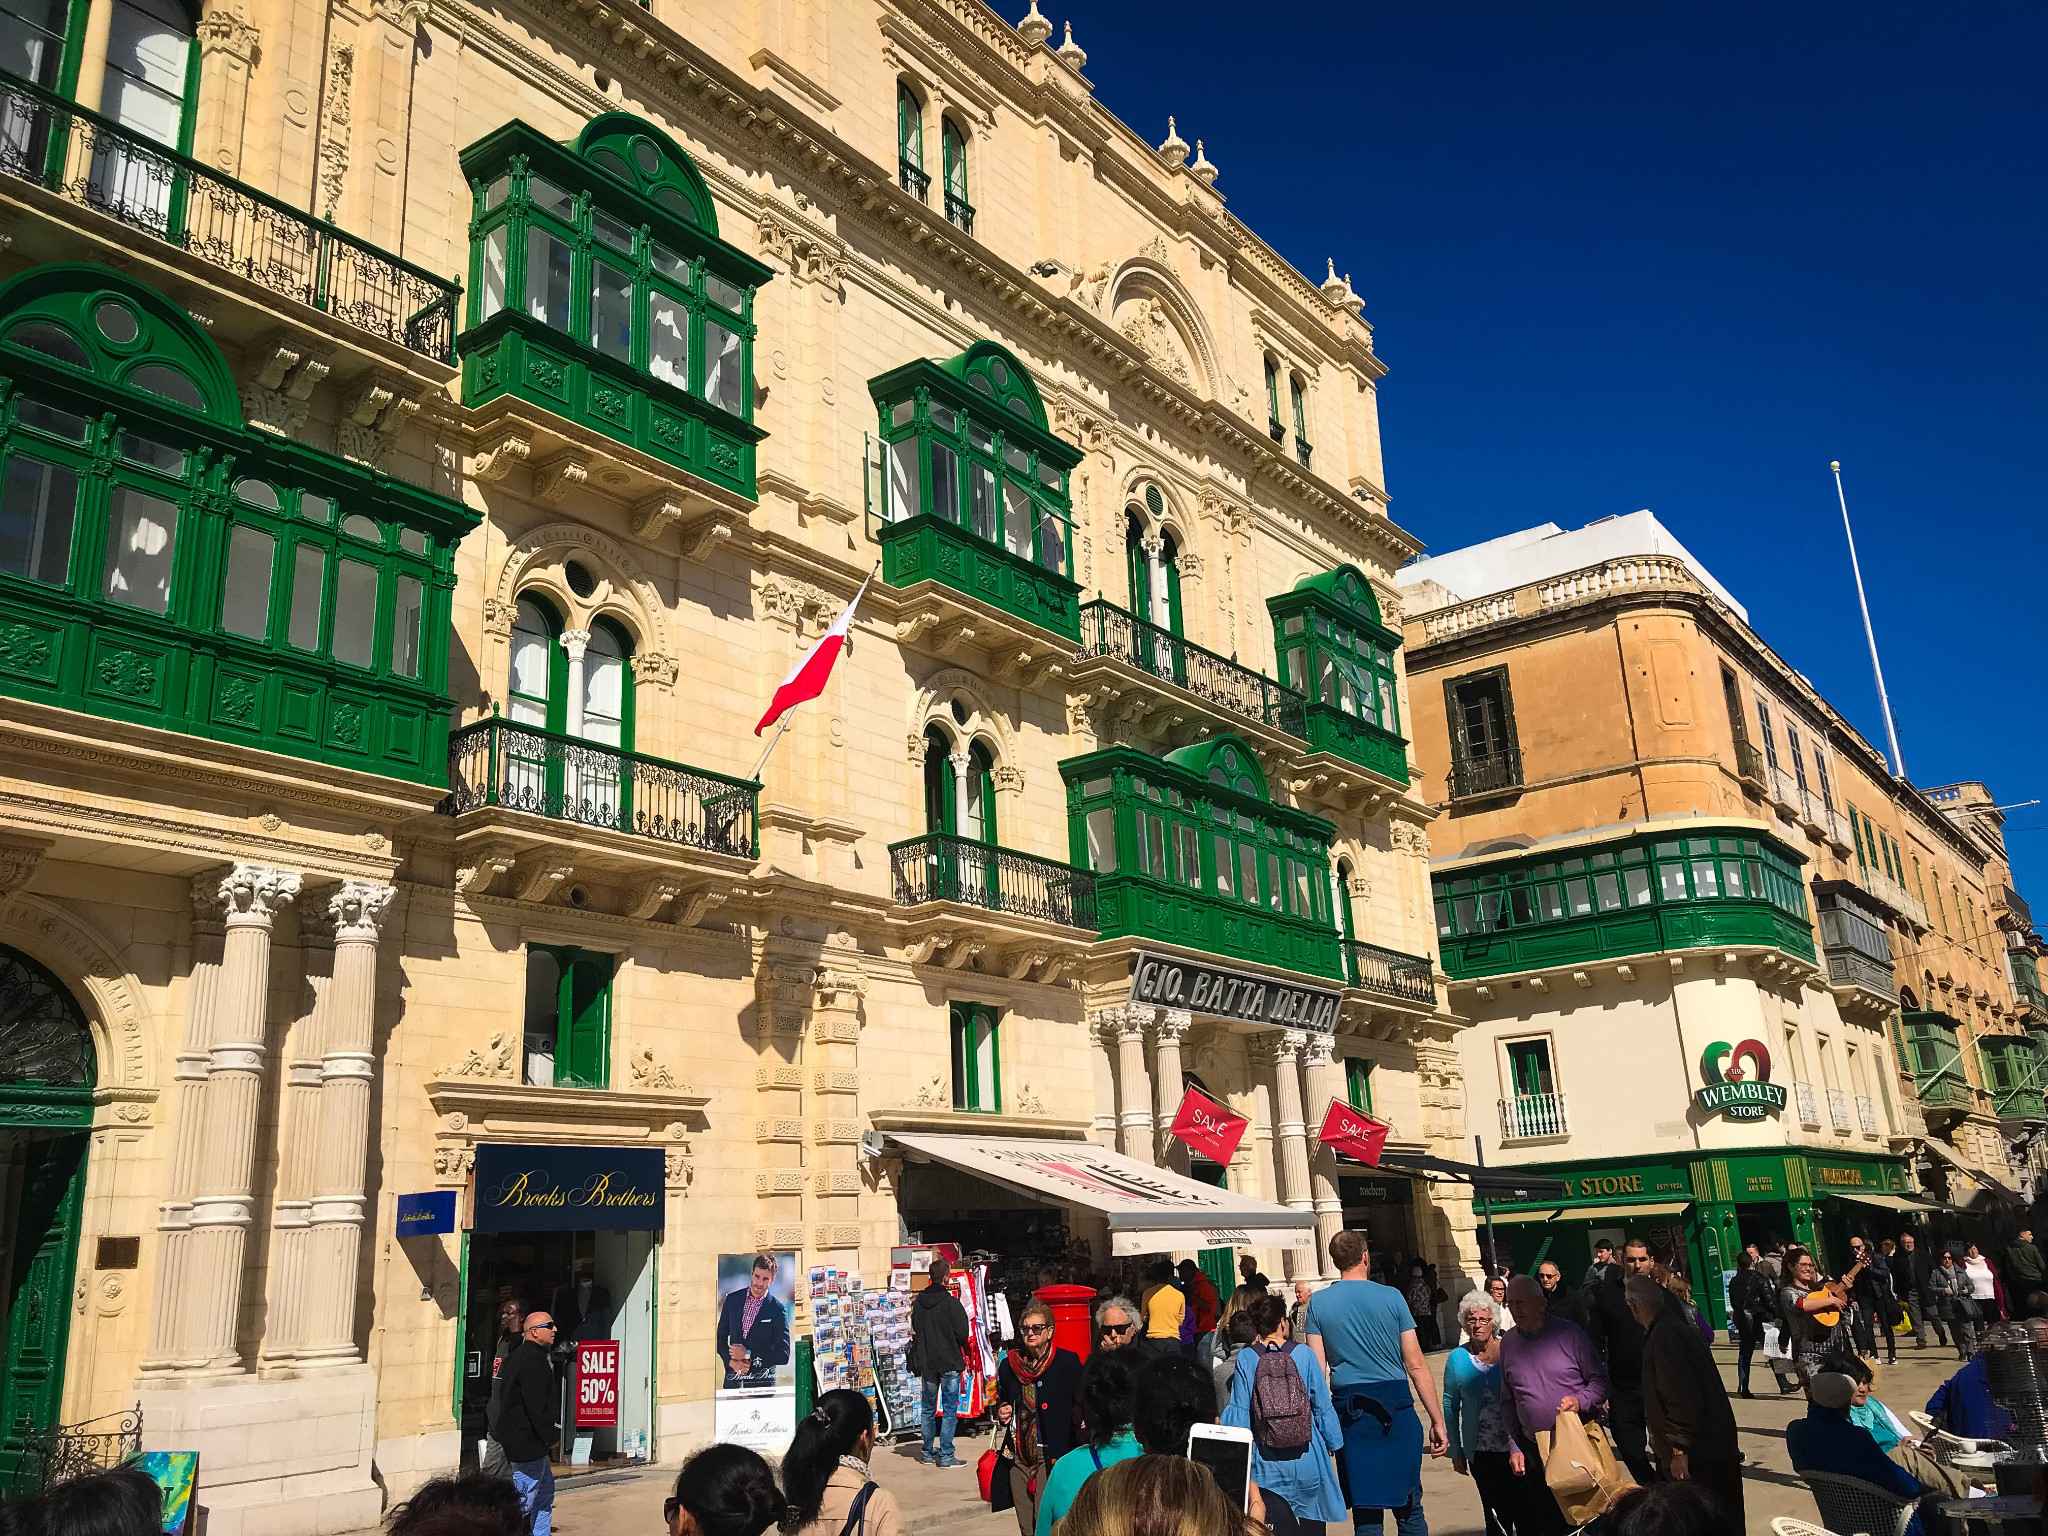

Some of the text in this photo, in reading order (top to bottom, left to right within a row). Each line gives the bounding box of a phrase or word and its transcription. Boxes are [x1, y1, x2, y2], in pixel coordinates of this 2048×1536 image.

[1141, 962, 1334, 1028] GIO. BATTA DELIA
[1702, 1083, 1783, 1108] WEMBLEY
[1193, 1108, 1228, 1138] SALE
[1730, 1105, 1765, 1117] STORE
[1340, 1118, 1371, 1142] SALE
[486, 1168, 657, 1208] Brooks Brothers
[1581, 1174, 1644, 1196] STORE
[581, 1351, 615, 1374] SALE
[580, 1378, 615, 1404] 50%
